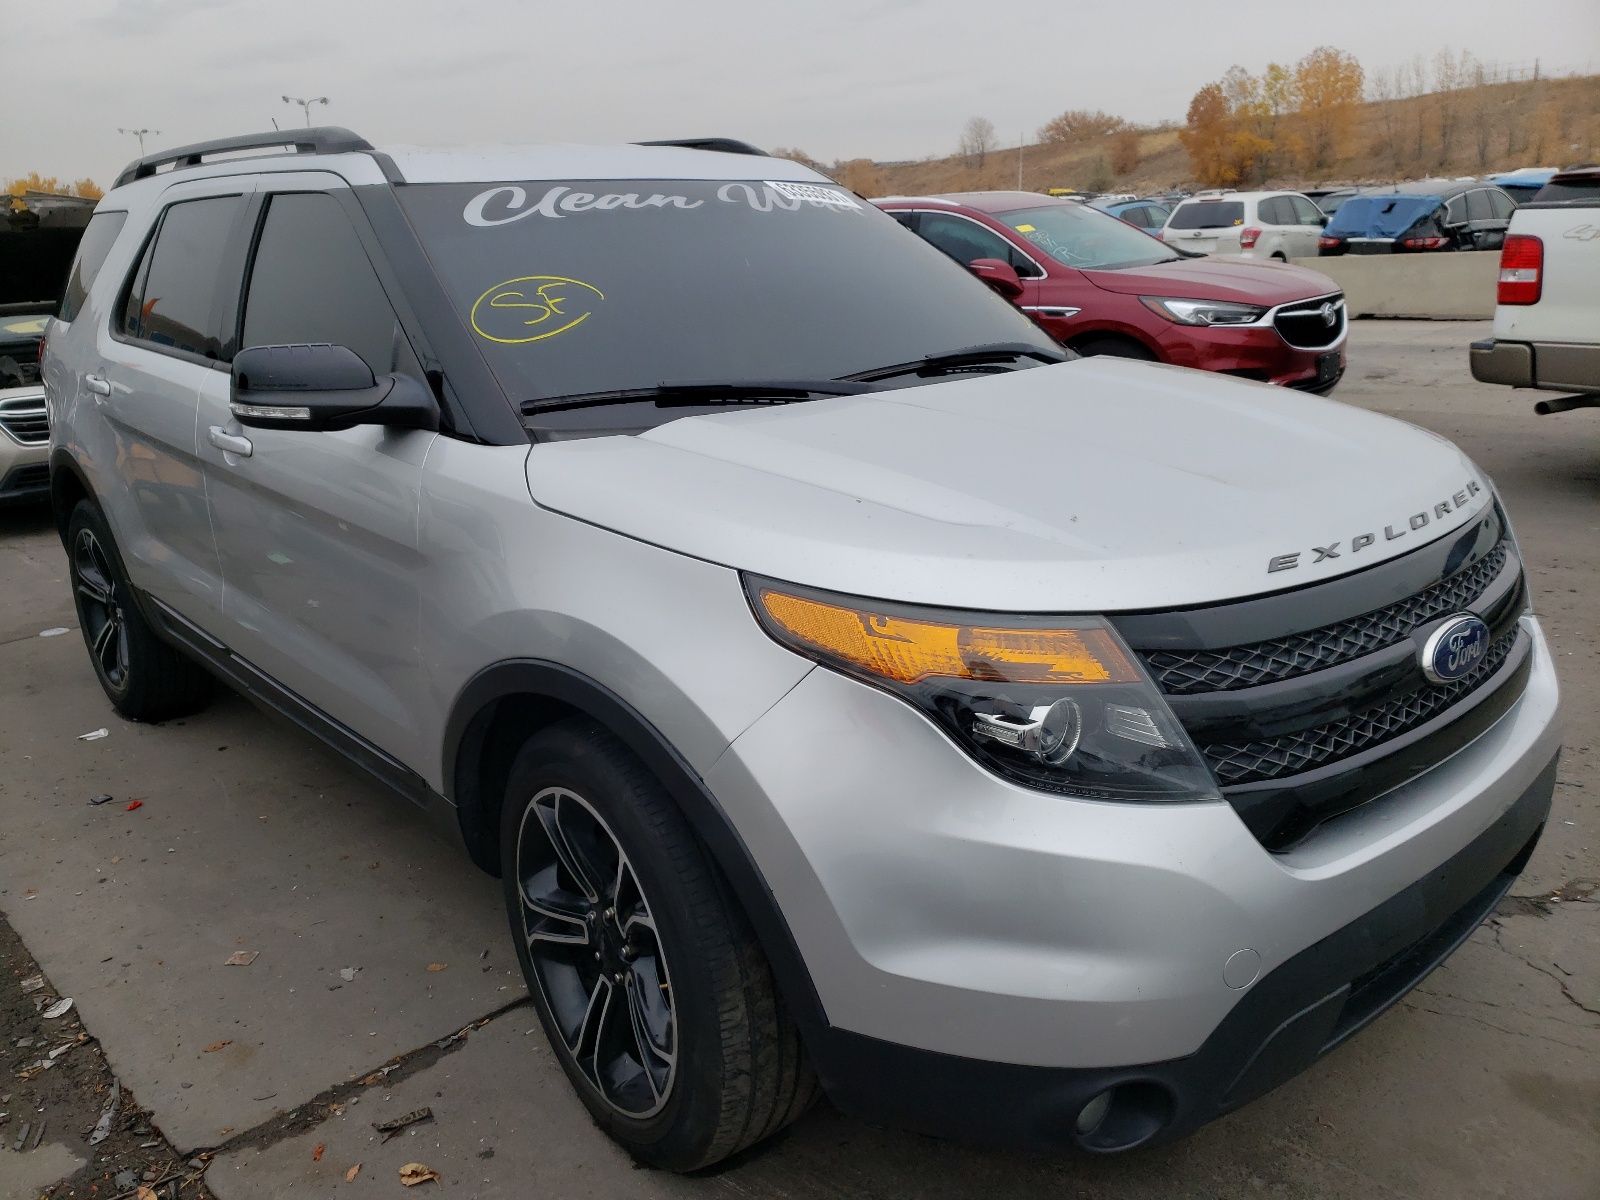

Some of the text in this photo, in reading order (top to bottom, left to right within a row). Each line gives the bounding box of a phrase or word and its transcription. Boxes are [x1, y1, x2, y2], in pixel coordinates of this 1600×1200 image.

[463, 186, 704, 227] Clean
[1267, 480, 1481, 573] EXPLORER
[1447, 628, 1482, 671] Ford
